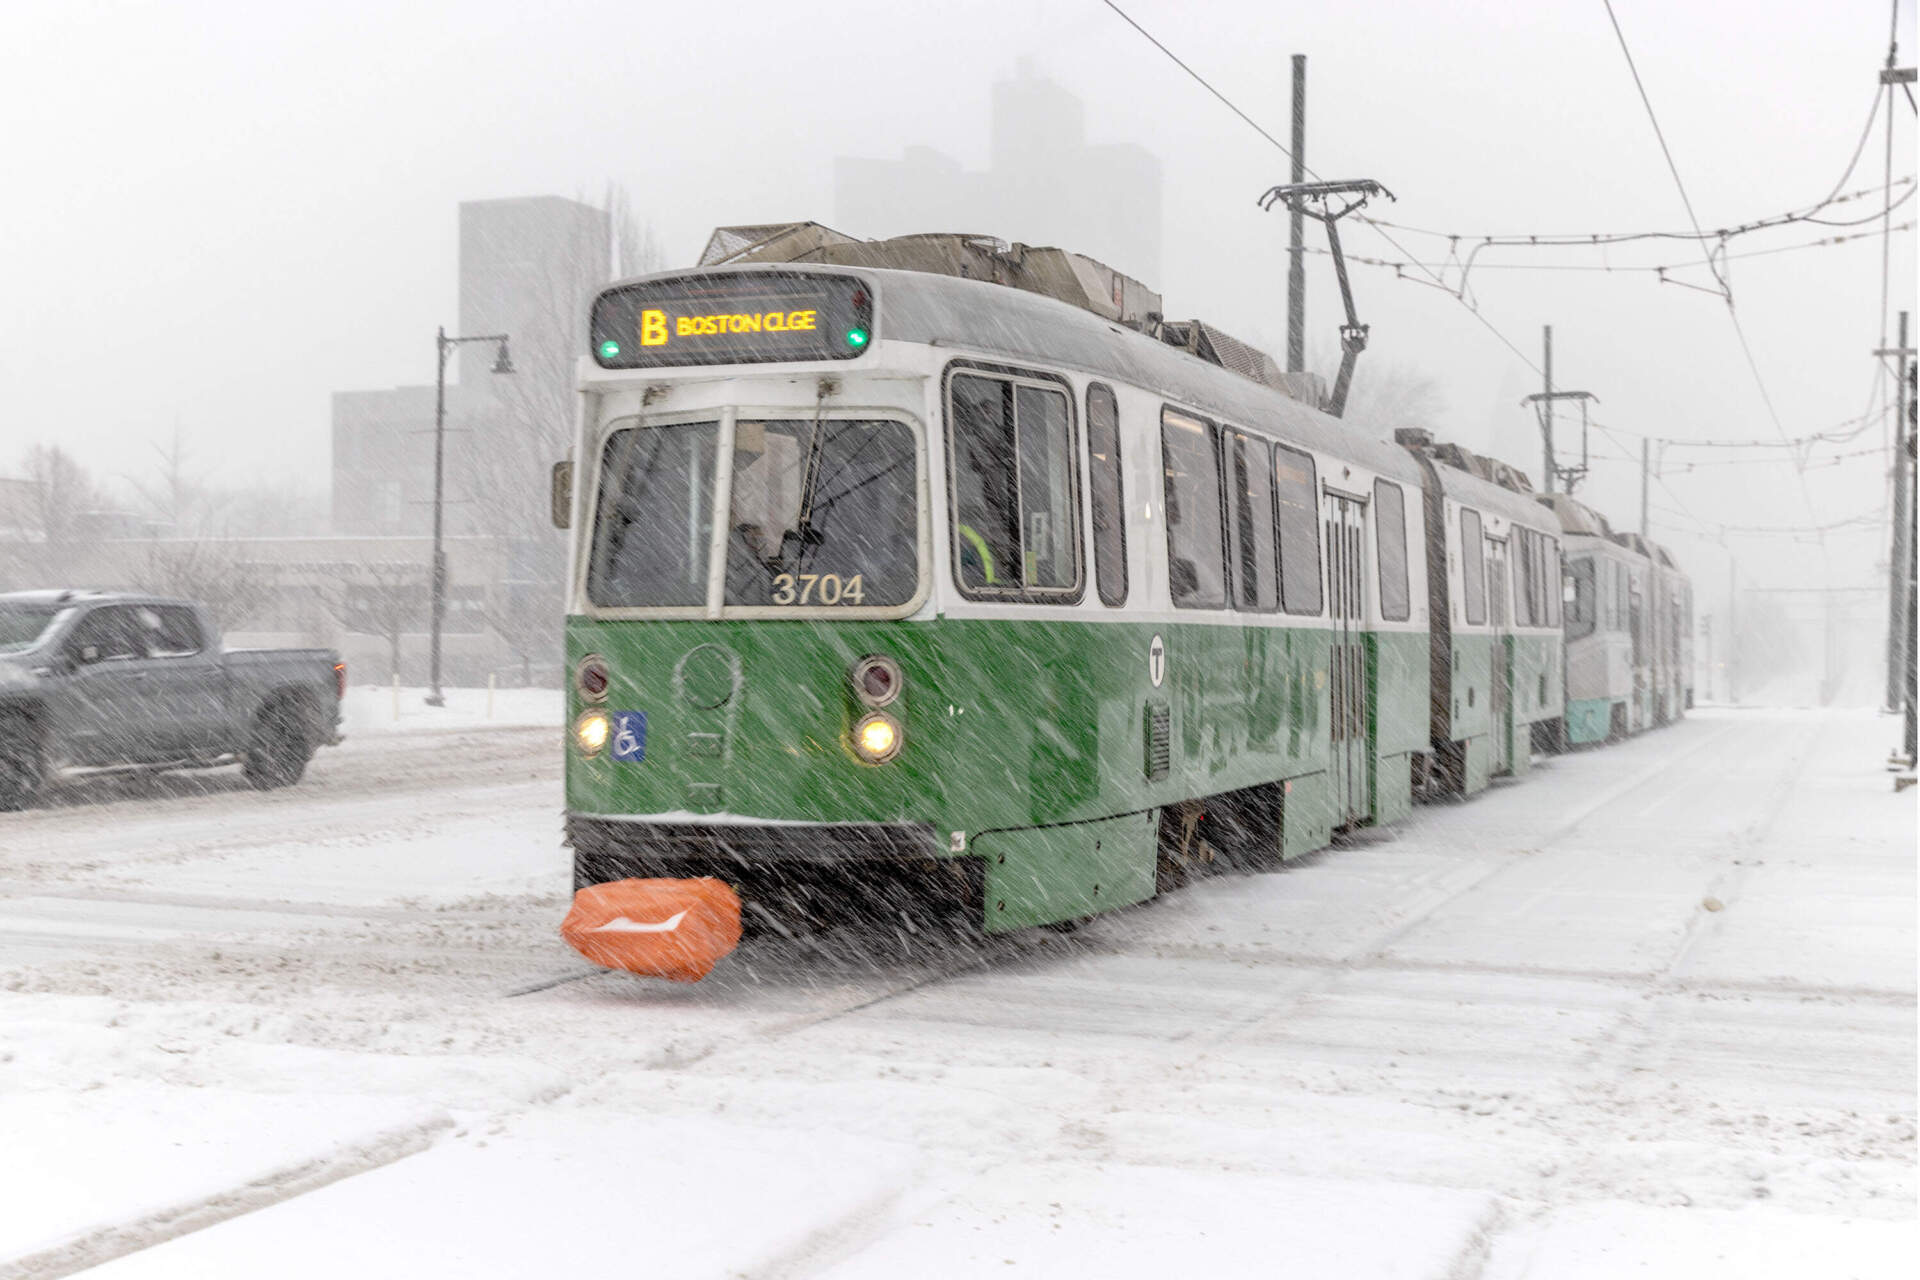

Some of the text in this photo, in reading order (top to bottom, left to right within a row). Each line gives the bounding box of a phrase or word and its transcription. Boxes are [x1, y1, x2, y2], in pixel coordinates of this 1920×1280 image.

[640, 309, 817, 346] B BOSTON CLGE
[772, 573, 865, 605] 3704
[1152, 647, 1163, 681] T
